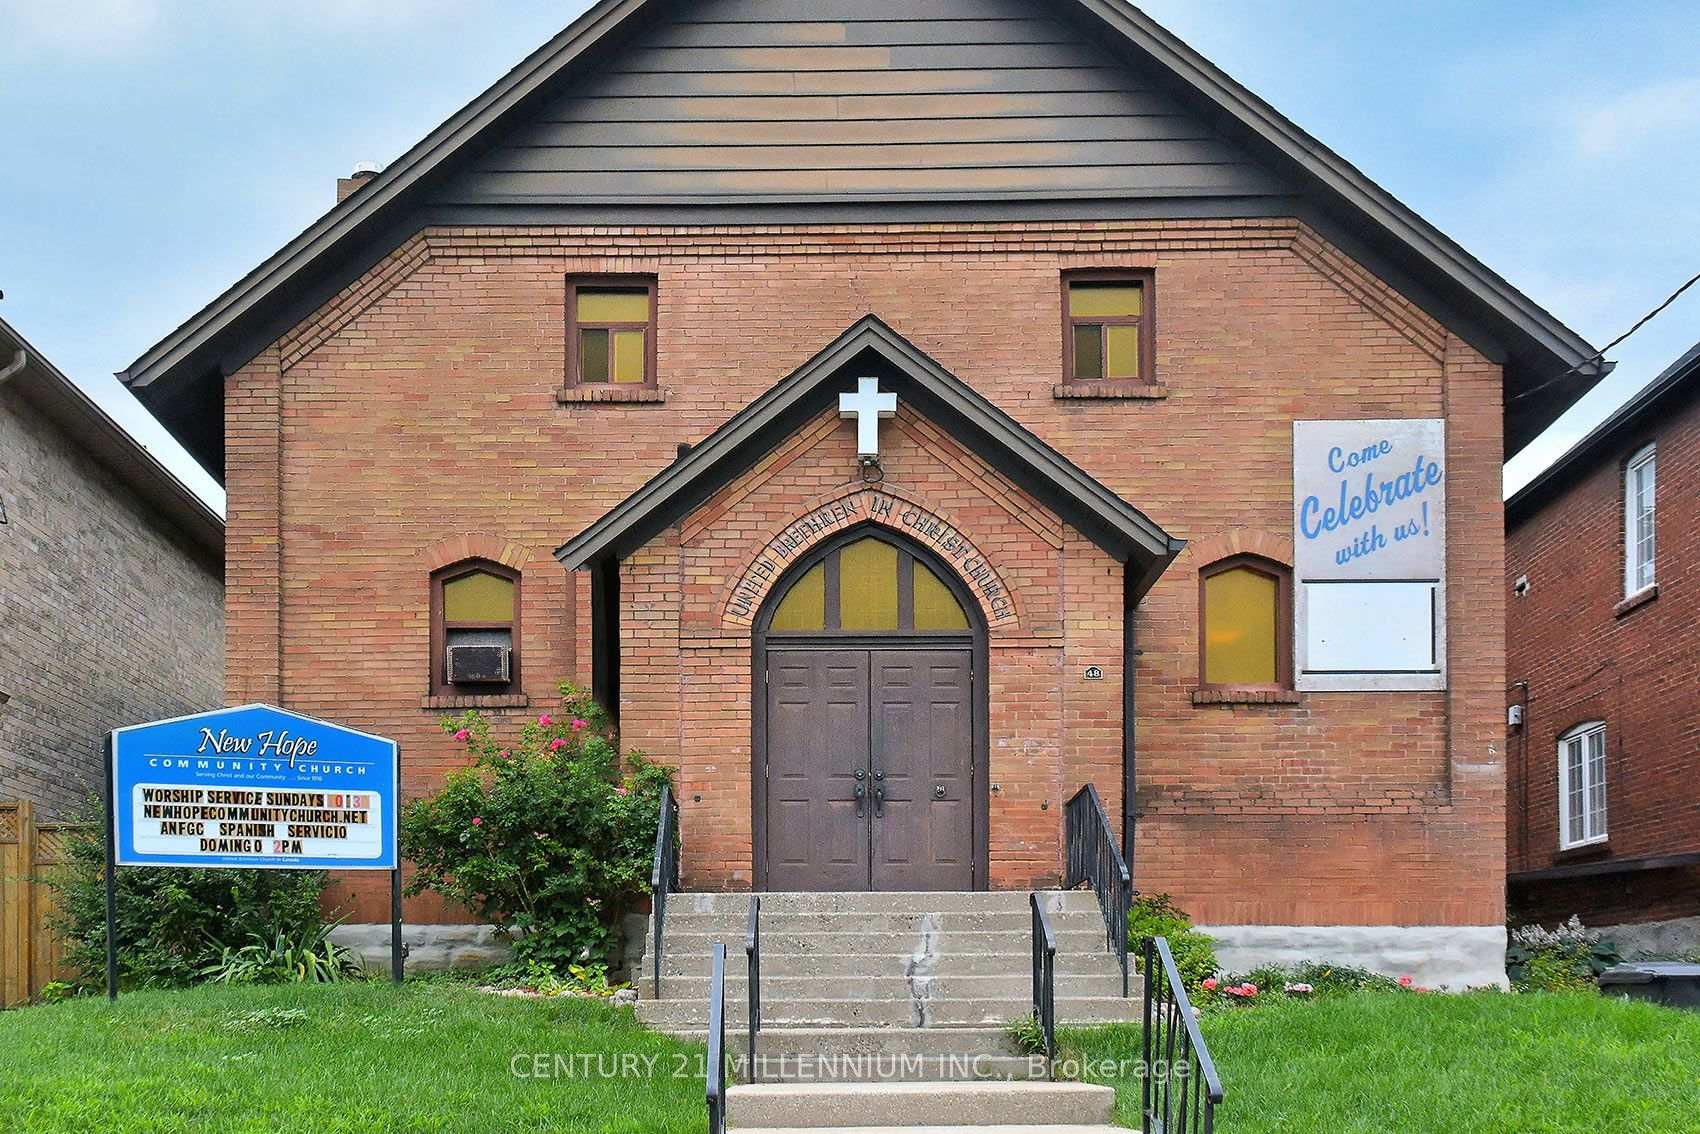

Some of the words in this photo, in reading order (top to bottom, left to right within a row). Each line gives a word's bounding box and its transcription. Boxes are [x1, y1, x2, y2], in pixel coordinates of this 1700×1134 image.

[1328, 440, 1392, 472] Come
[1300, 456, 1442, 539] Celebrate
[1336, 525, 1386, 565] with
[1394, 501, 1430, 541] us!
[732, 560, 776, 616] UNITED
[772, 500, 858, 560] BRETHREN
[871, 496, 893, 518] IN
[902, 510, 968, 560] CHRIST
[963, 557, 1011, 621] CHURCH
[197, 728, 252, 753] New
[258, 730, 318, 768] Hope
[150, 758, 282, 772] COMMUNITY
[298, 765, 366, 775] CHURCH
[142, 788, 203, 802] WORSHIP
[208, 791, 262, 805] SERVICE
[266, 793, 324, 806] SUNDAYS
[160, 822, 204, 836] ANFGC
[288, 825, 346, 838] SERVICIO
[200, 839, 262, 852] DOMINGO
